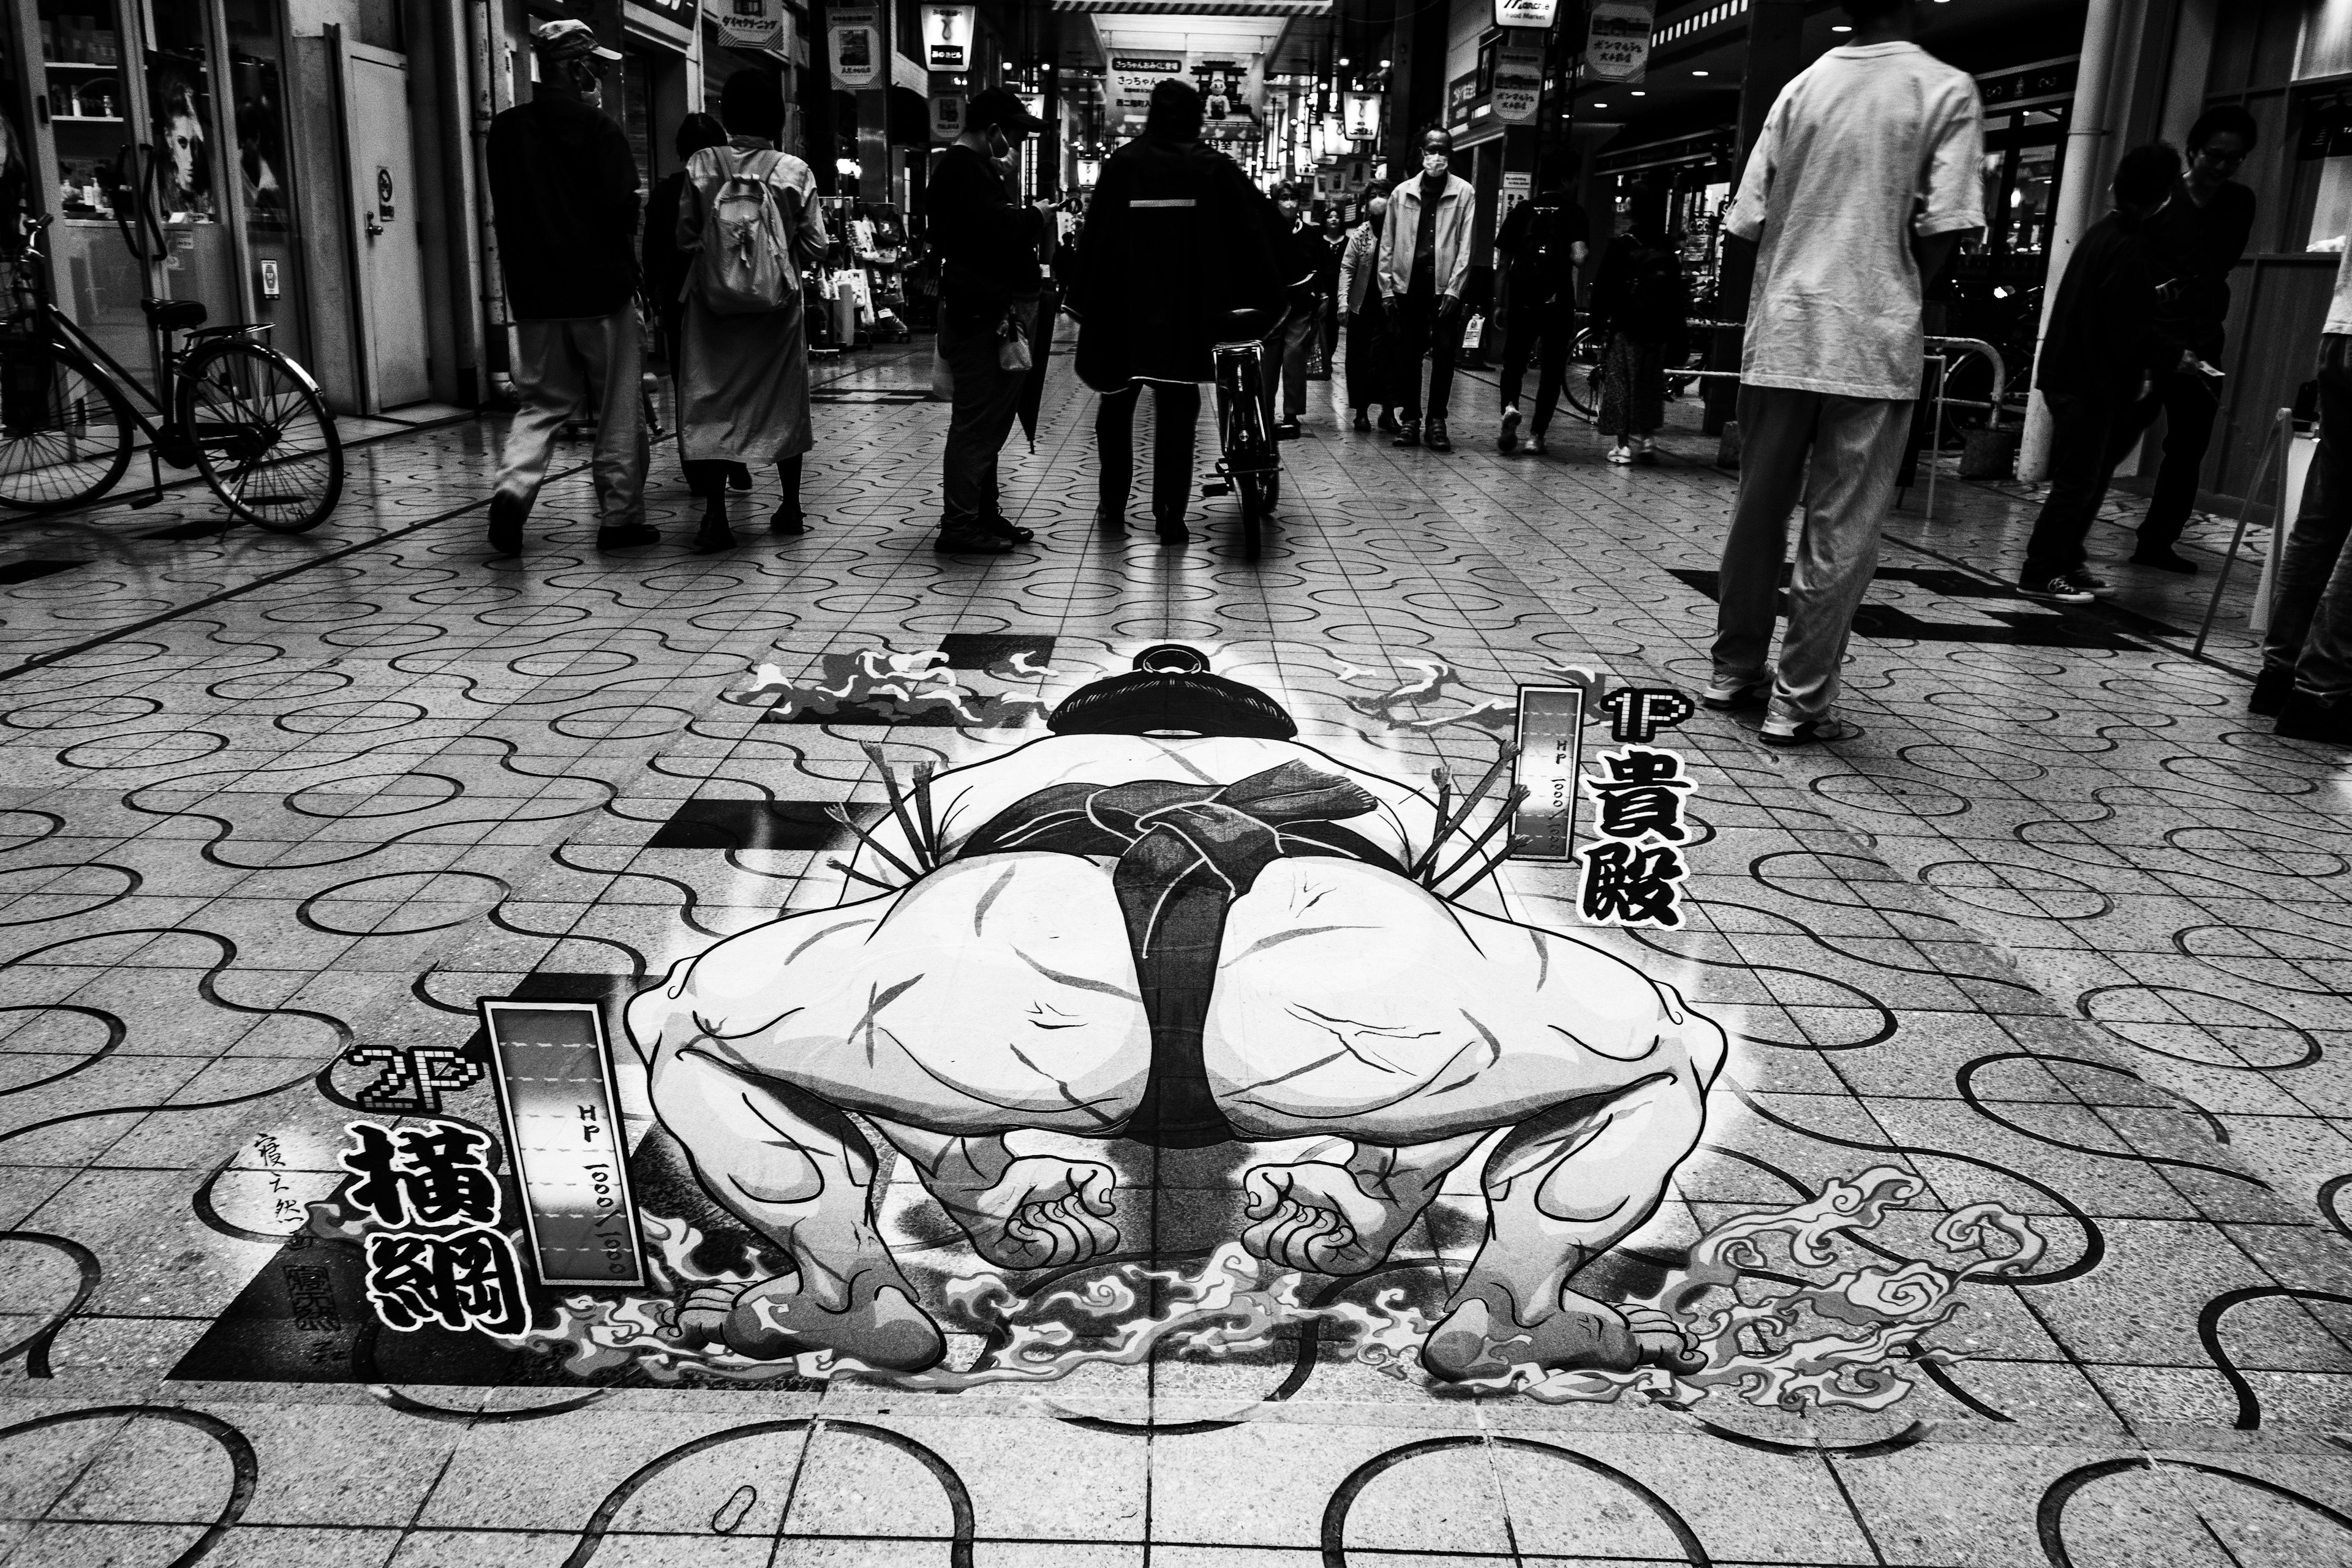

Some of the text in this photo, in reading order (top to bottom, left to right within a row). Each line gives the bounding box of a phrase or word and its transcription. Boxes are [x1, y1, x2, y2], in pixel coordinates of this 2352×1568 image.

[1604, 690, 1691, 739] 1P
[1555, 739, 1569, 765] HP
[1579, 747, 1697, 929] 貴殿
[350, 1041, 481, 1111] 2P
[577, 1104, 601, 1143] HP
[341, 1122, 531, 1336] 横綱
